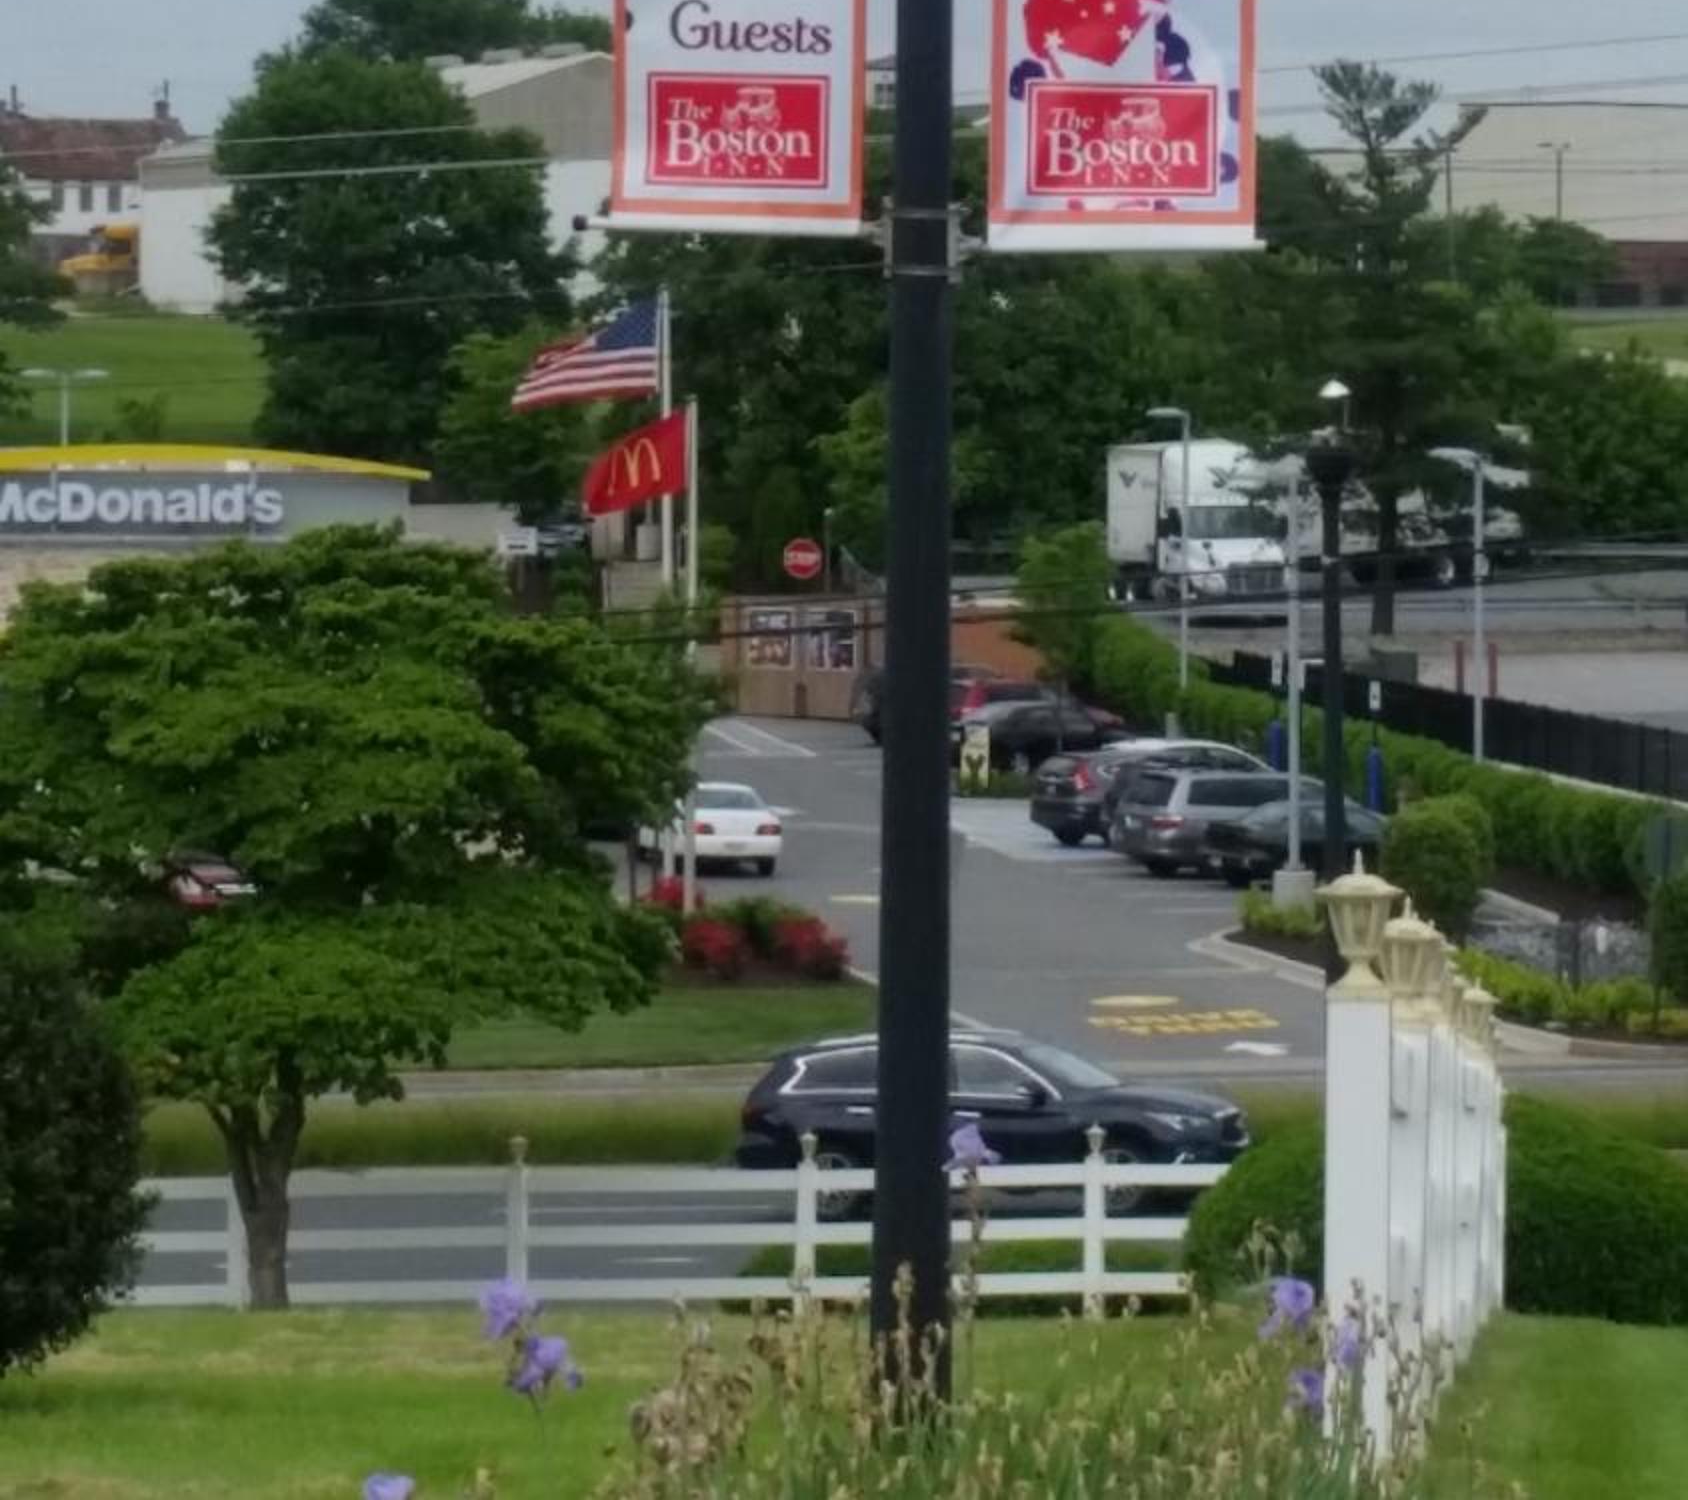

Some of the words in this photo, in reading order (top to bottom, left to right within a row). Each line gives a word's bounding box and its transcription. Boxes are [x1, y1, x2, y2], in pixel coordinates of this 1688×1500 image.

[667, 96, 714, 121] The
[1049, 106, 1096, 131] The
[665, 118, 813, 167] Boston
[1044, 128, 1199, 177] Boston
